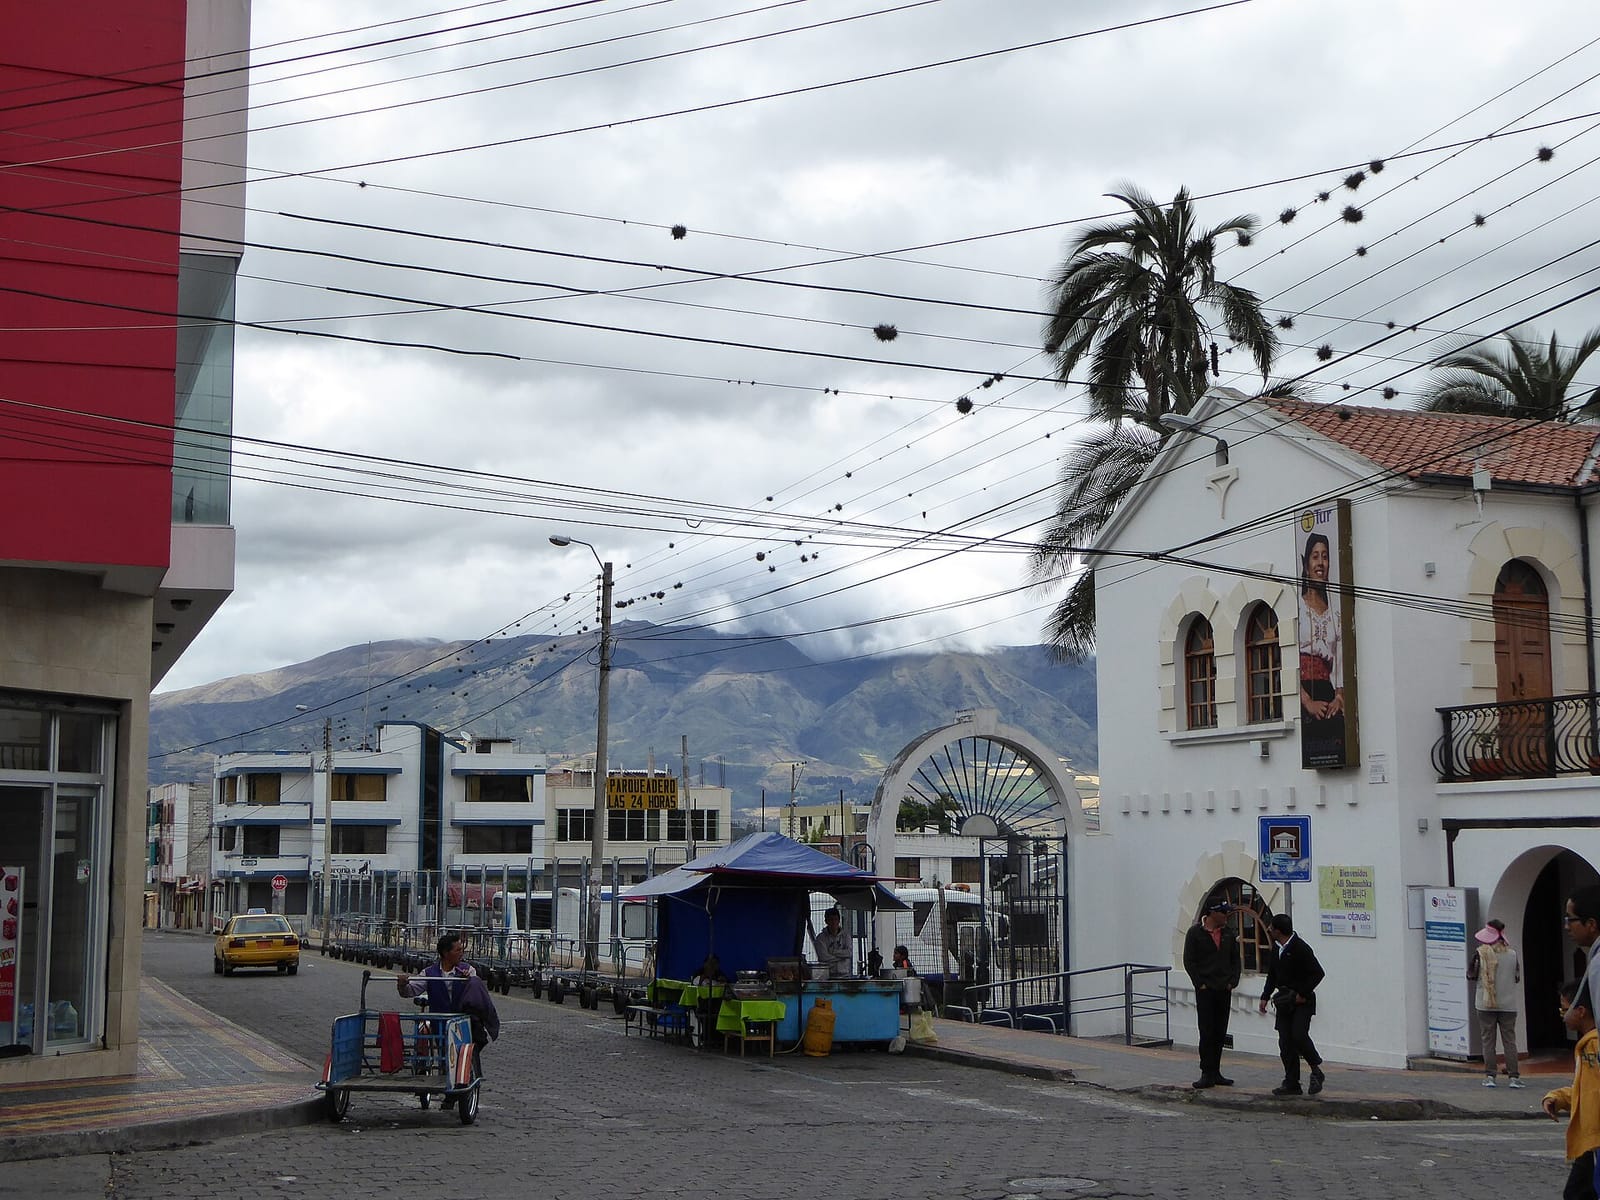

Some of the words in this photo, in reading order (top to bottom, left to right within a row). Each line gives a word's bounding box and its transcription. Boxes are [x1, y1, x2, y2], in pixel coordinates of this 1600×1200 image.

[610, 779, 676, 794] PARQUEADERO
[608, 795, 625, 808] LAS
[631, 795, 643, 808] 24
[649, 795, 676, 808] HORAS
[272, 879, 286, 887] PARE
[1343, 899, 1366, 908] Welcome
[1347, 911, 1371, 921] otavalo
